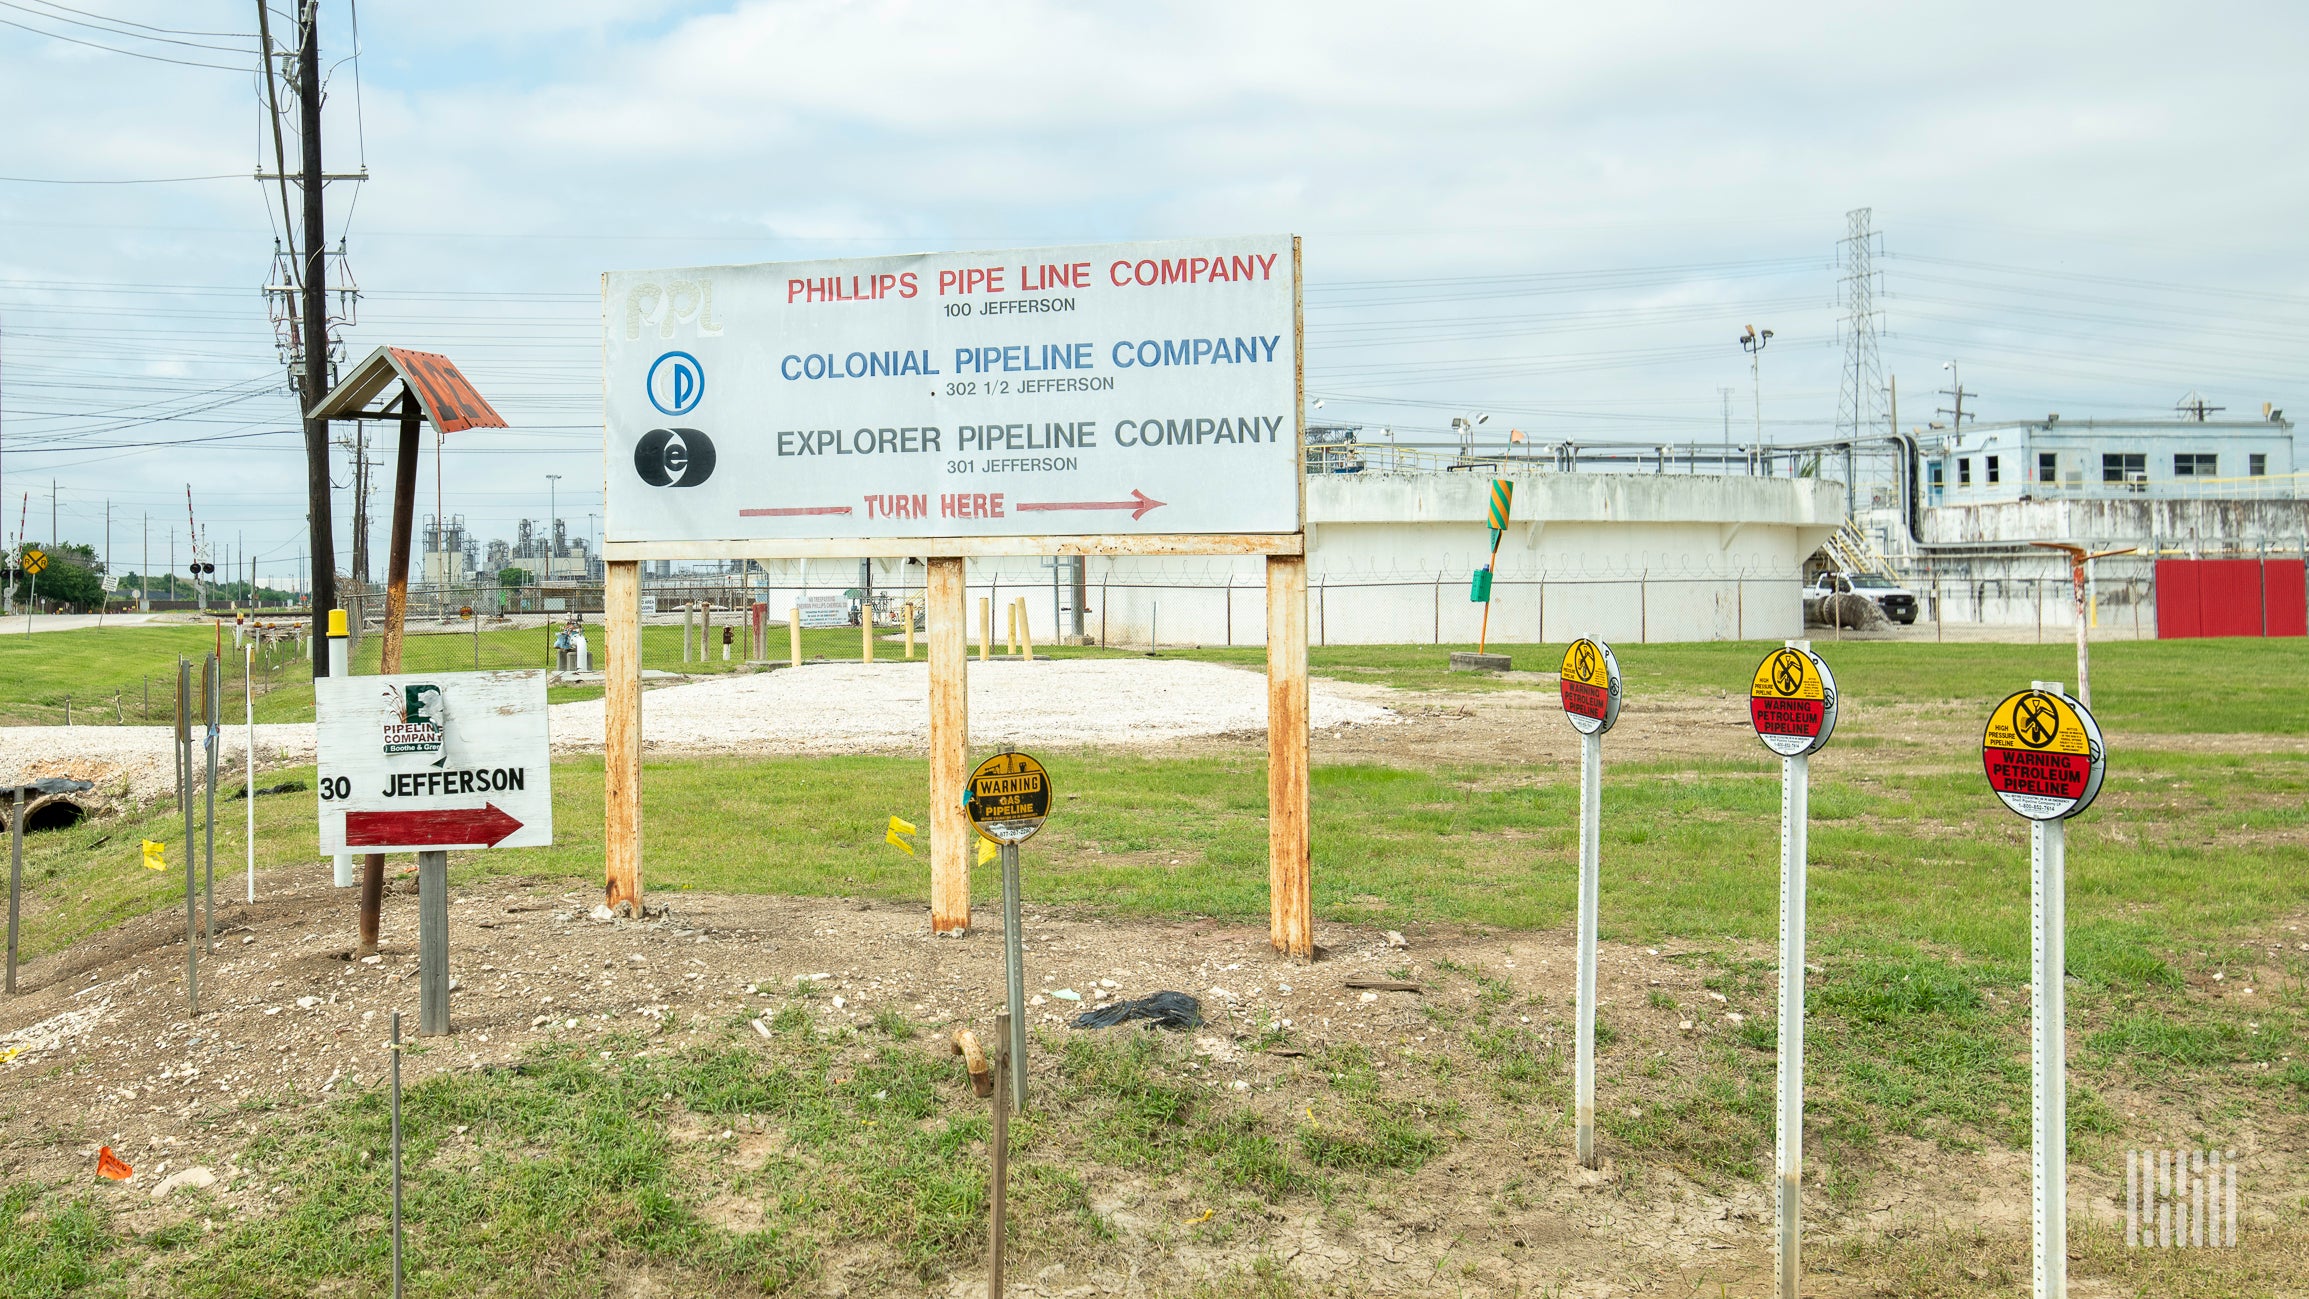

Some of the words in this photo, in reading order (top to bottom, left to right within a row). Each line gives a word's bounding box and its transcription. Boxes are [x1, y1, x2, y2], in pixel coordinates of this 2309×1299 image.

[788, 273, 917, 305] PHILLIPS
[939, 267, 1004, 296] PIPE
[1022, 262, 1091, 292] LINE
[1109, 253, 1278, 287] COMPANY
[944, 303, 972, 318] 100
[979, 298, 1075, 316] JEFFERSON
[781, 350, 940, 381] COLONIAL
[956, 343, 1094, 374] PIPELINE
[1112, 335, 1280, 369] COMPANY
[946, 382, 976, 397] 302
[984, 380, 1010, 396] 1/2
[1017, 377, 1114, 394] JEFFERSON
[777, 427, 941, 457] EXPLORER
[959, 421, 1097, 451] PIPELINE
[1114, 416, 1284, 448] COMPANY
[947, 459, 974, 474] 301
[982, 457, 1077, 473] JEFFERSON
[864, 494, 927, 520] TURN
[941, 492, 1005, 519] HERE
[1569, 683, 1600, 697] WARNING
[1565, 691, 1604, 708] PETROLEUM
[1764, 700, 1811, 711] WARNING
[1569, 702, 1599, 717] PIPELINE
[1757, 711, 1817, 723] PETROLEUM
[1764, 722, 1810, 734] PIPELINE
[384, 733, 443, 744] COMPANY
[2002, 752, 2071, 768] WARNING
[1993, 764, 2080, 783] PETROLEUM
[320, 776, 351, 800] 30
[382, 767, 525, 798] JEFFERSON
[981, 776, 1038, 794] WARNING
[2004, 778, 2069, 795] PIPELINE
[999, 795, 1021, 806] GAS
[985, 803, 1034, 817] PIPELINE
